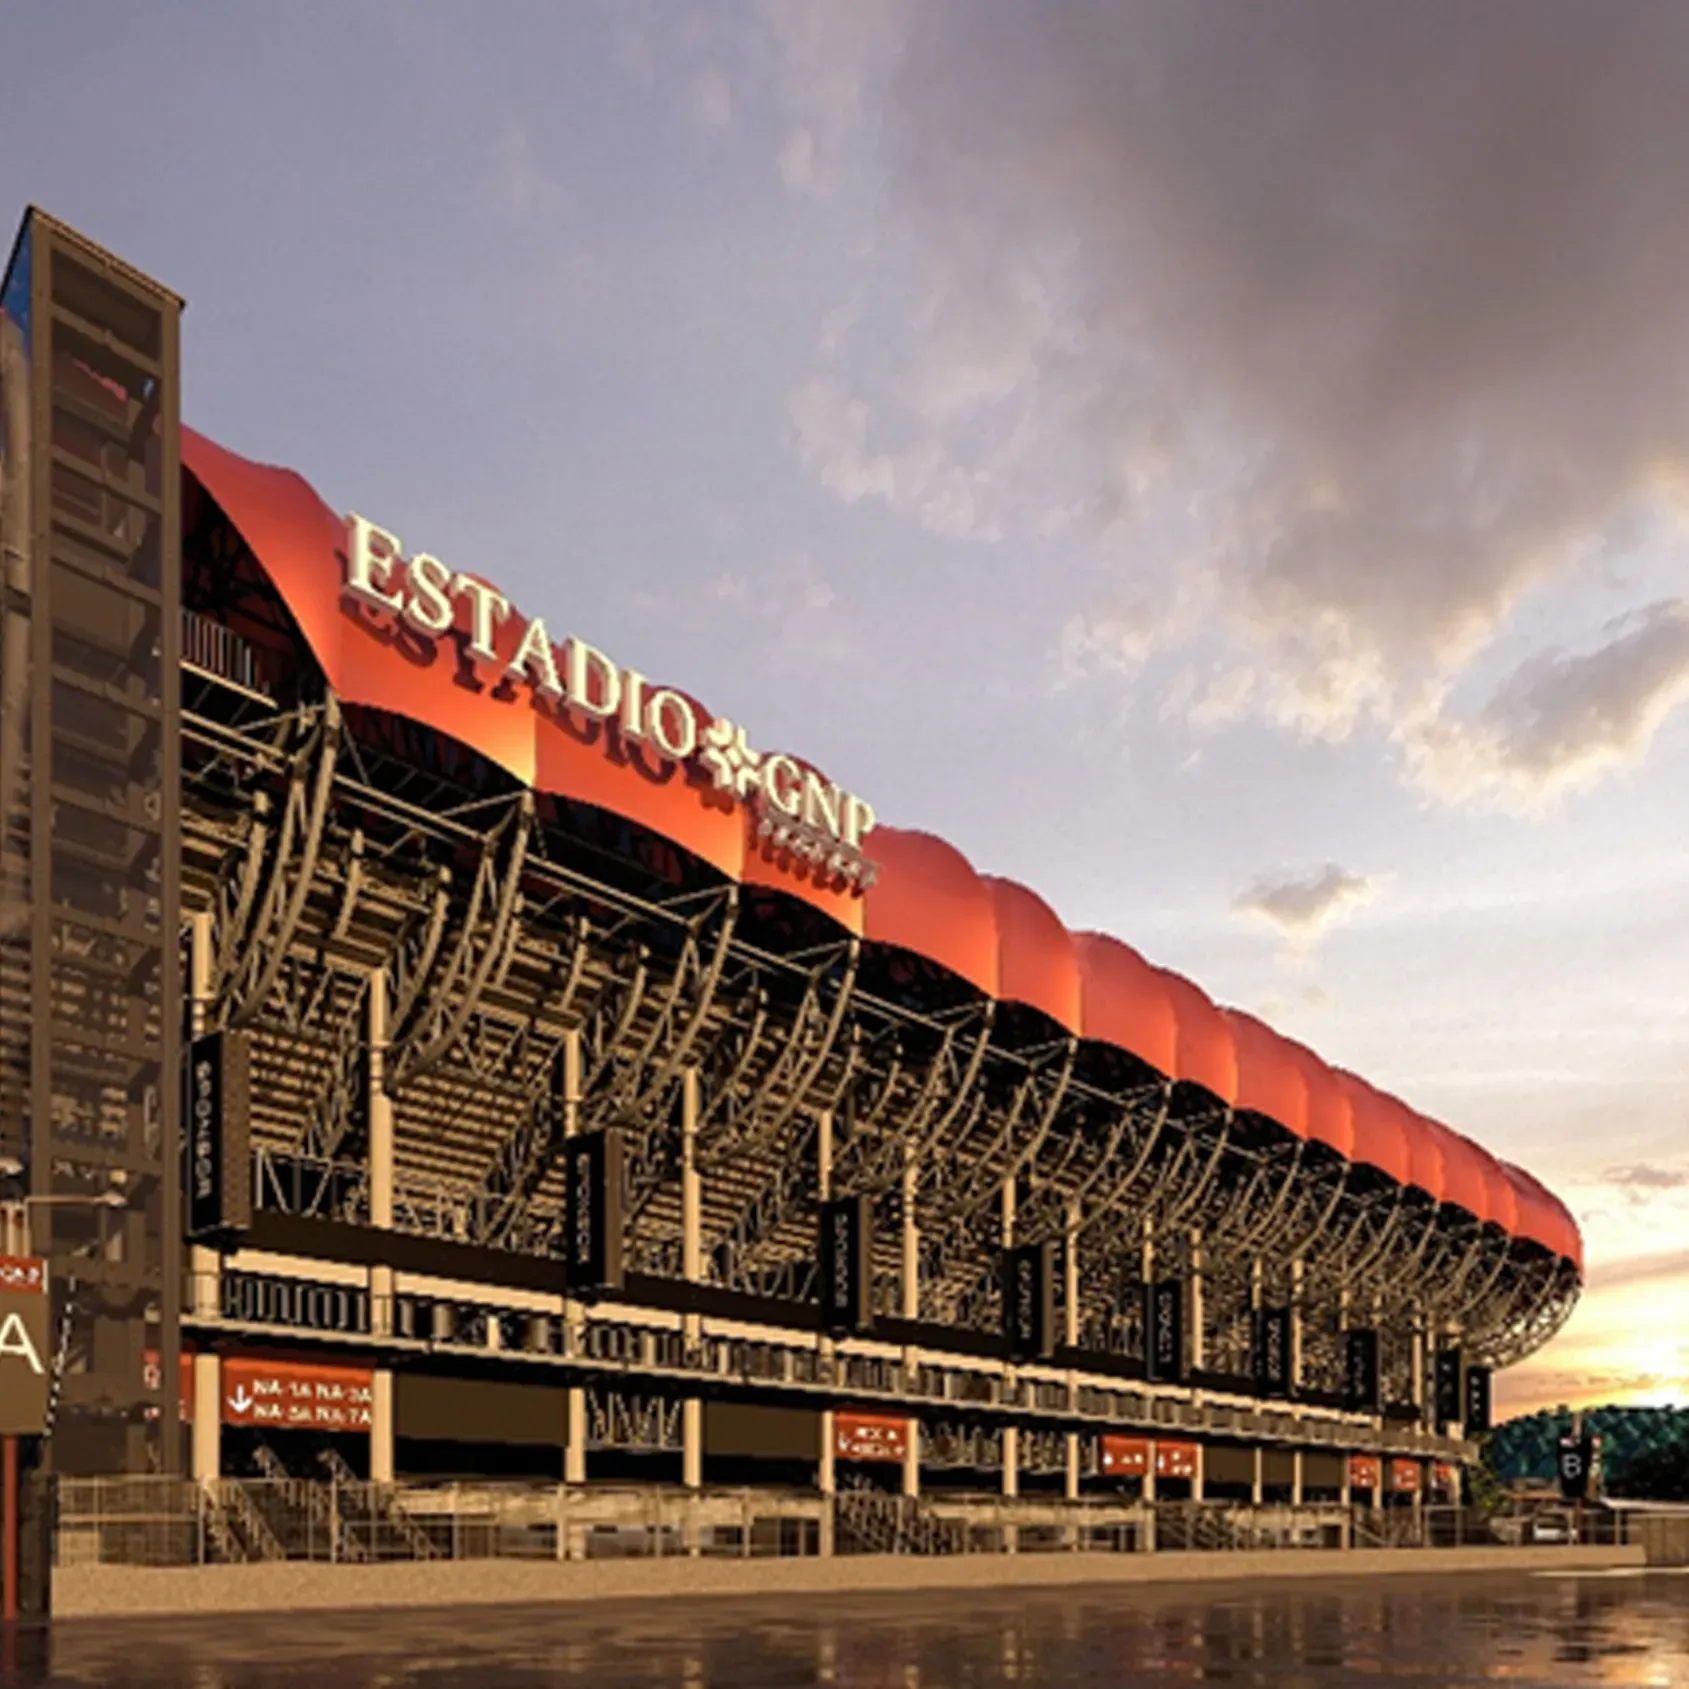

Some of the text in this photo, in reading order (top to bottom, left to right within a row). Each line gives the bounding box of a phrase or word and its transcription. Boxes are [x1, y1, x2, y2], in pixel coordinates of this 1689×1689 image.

[345, 511, 876, 851] ESTADIO GNP
[0, 1313, 45, 1375] A
